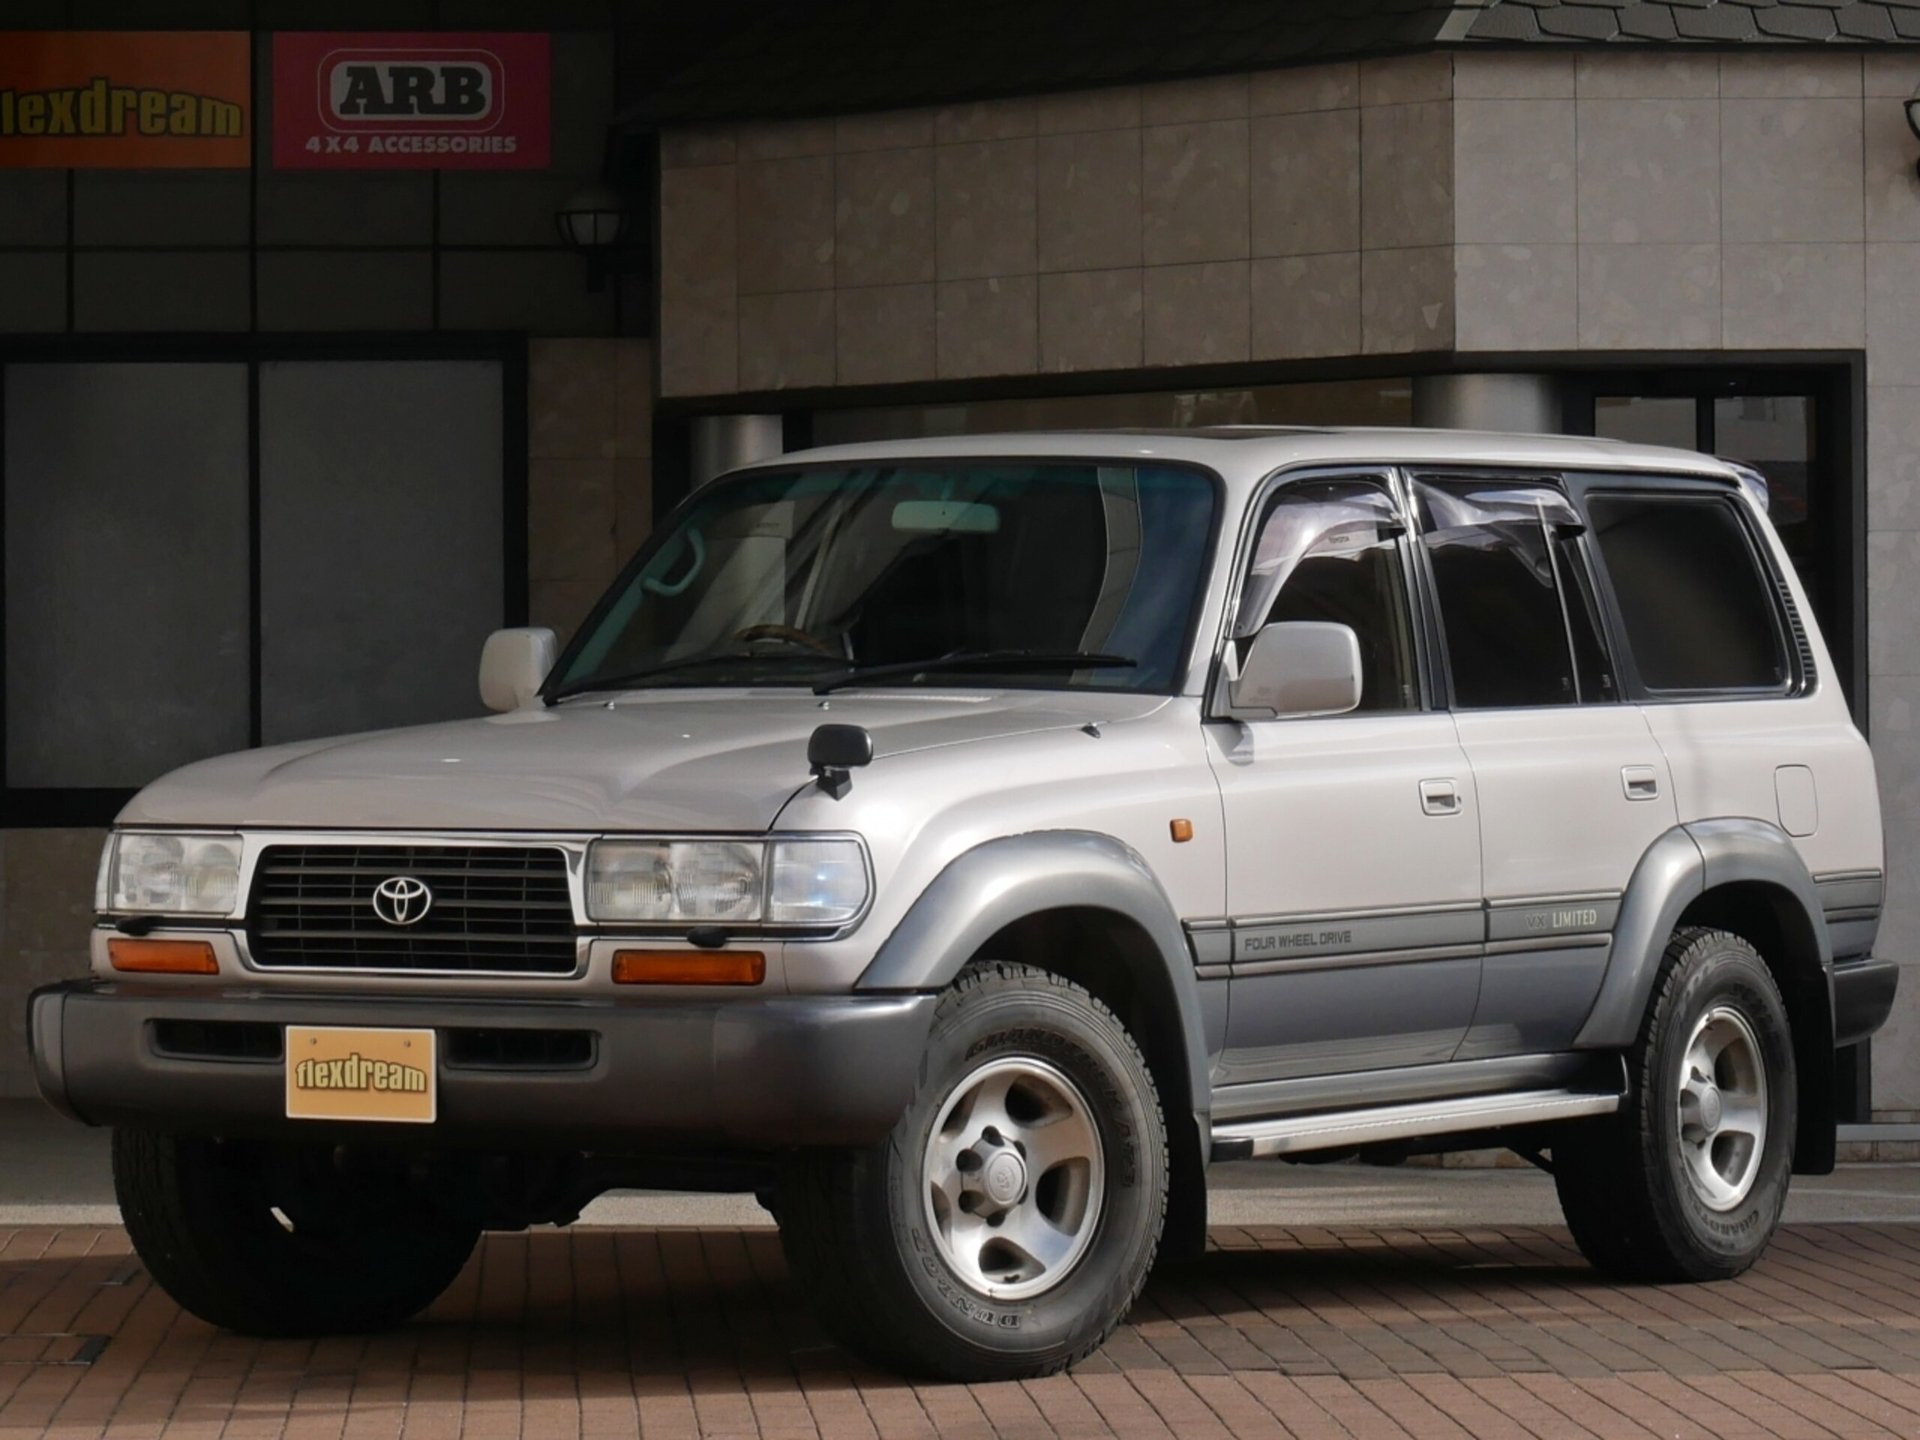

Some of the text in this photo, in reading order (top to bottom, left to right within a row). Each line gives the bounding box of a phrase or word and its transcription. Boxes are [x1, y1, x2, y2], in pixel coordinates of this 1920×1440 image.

[339, 65, 487, 116] ARB
[0, 77, 242, 138] lexdream
[305, 135, 517, 154] 4X4 ACCESSORIES
[1525, 908, 1598, 930] VX LIMITED
[1244, 930, 1353, 952] FOUR WHEEL DRIVE
[296, 1051, 427, 1093] flexdream
